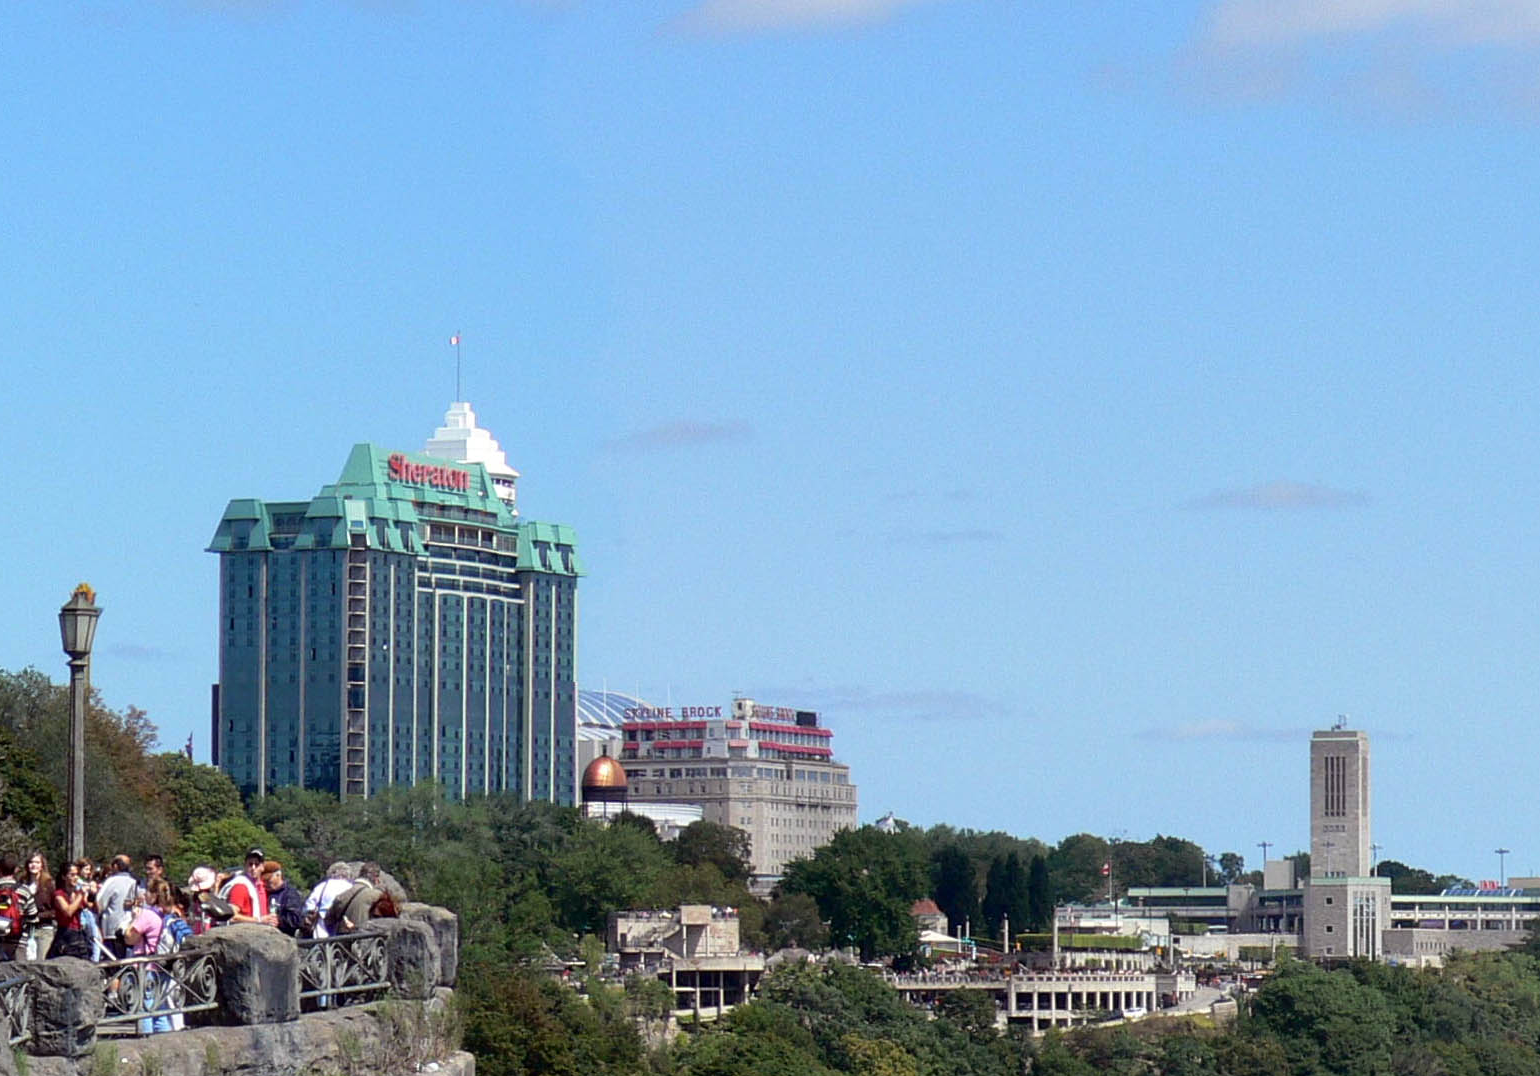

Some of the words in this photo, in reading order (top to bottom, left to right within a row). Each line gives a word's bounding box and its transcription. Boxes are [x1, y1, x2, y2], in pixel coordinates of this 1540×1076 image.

[387, 454, 469, 491] Sheraton
[623, 706, 672, 719] SKYLINE
[682, 706, 722, 718] BROCK
